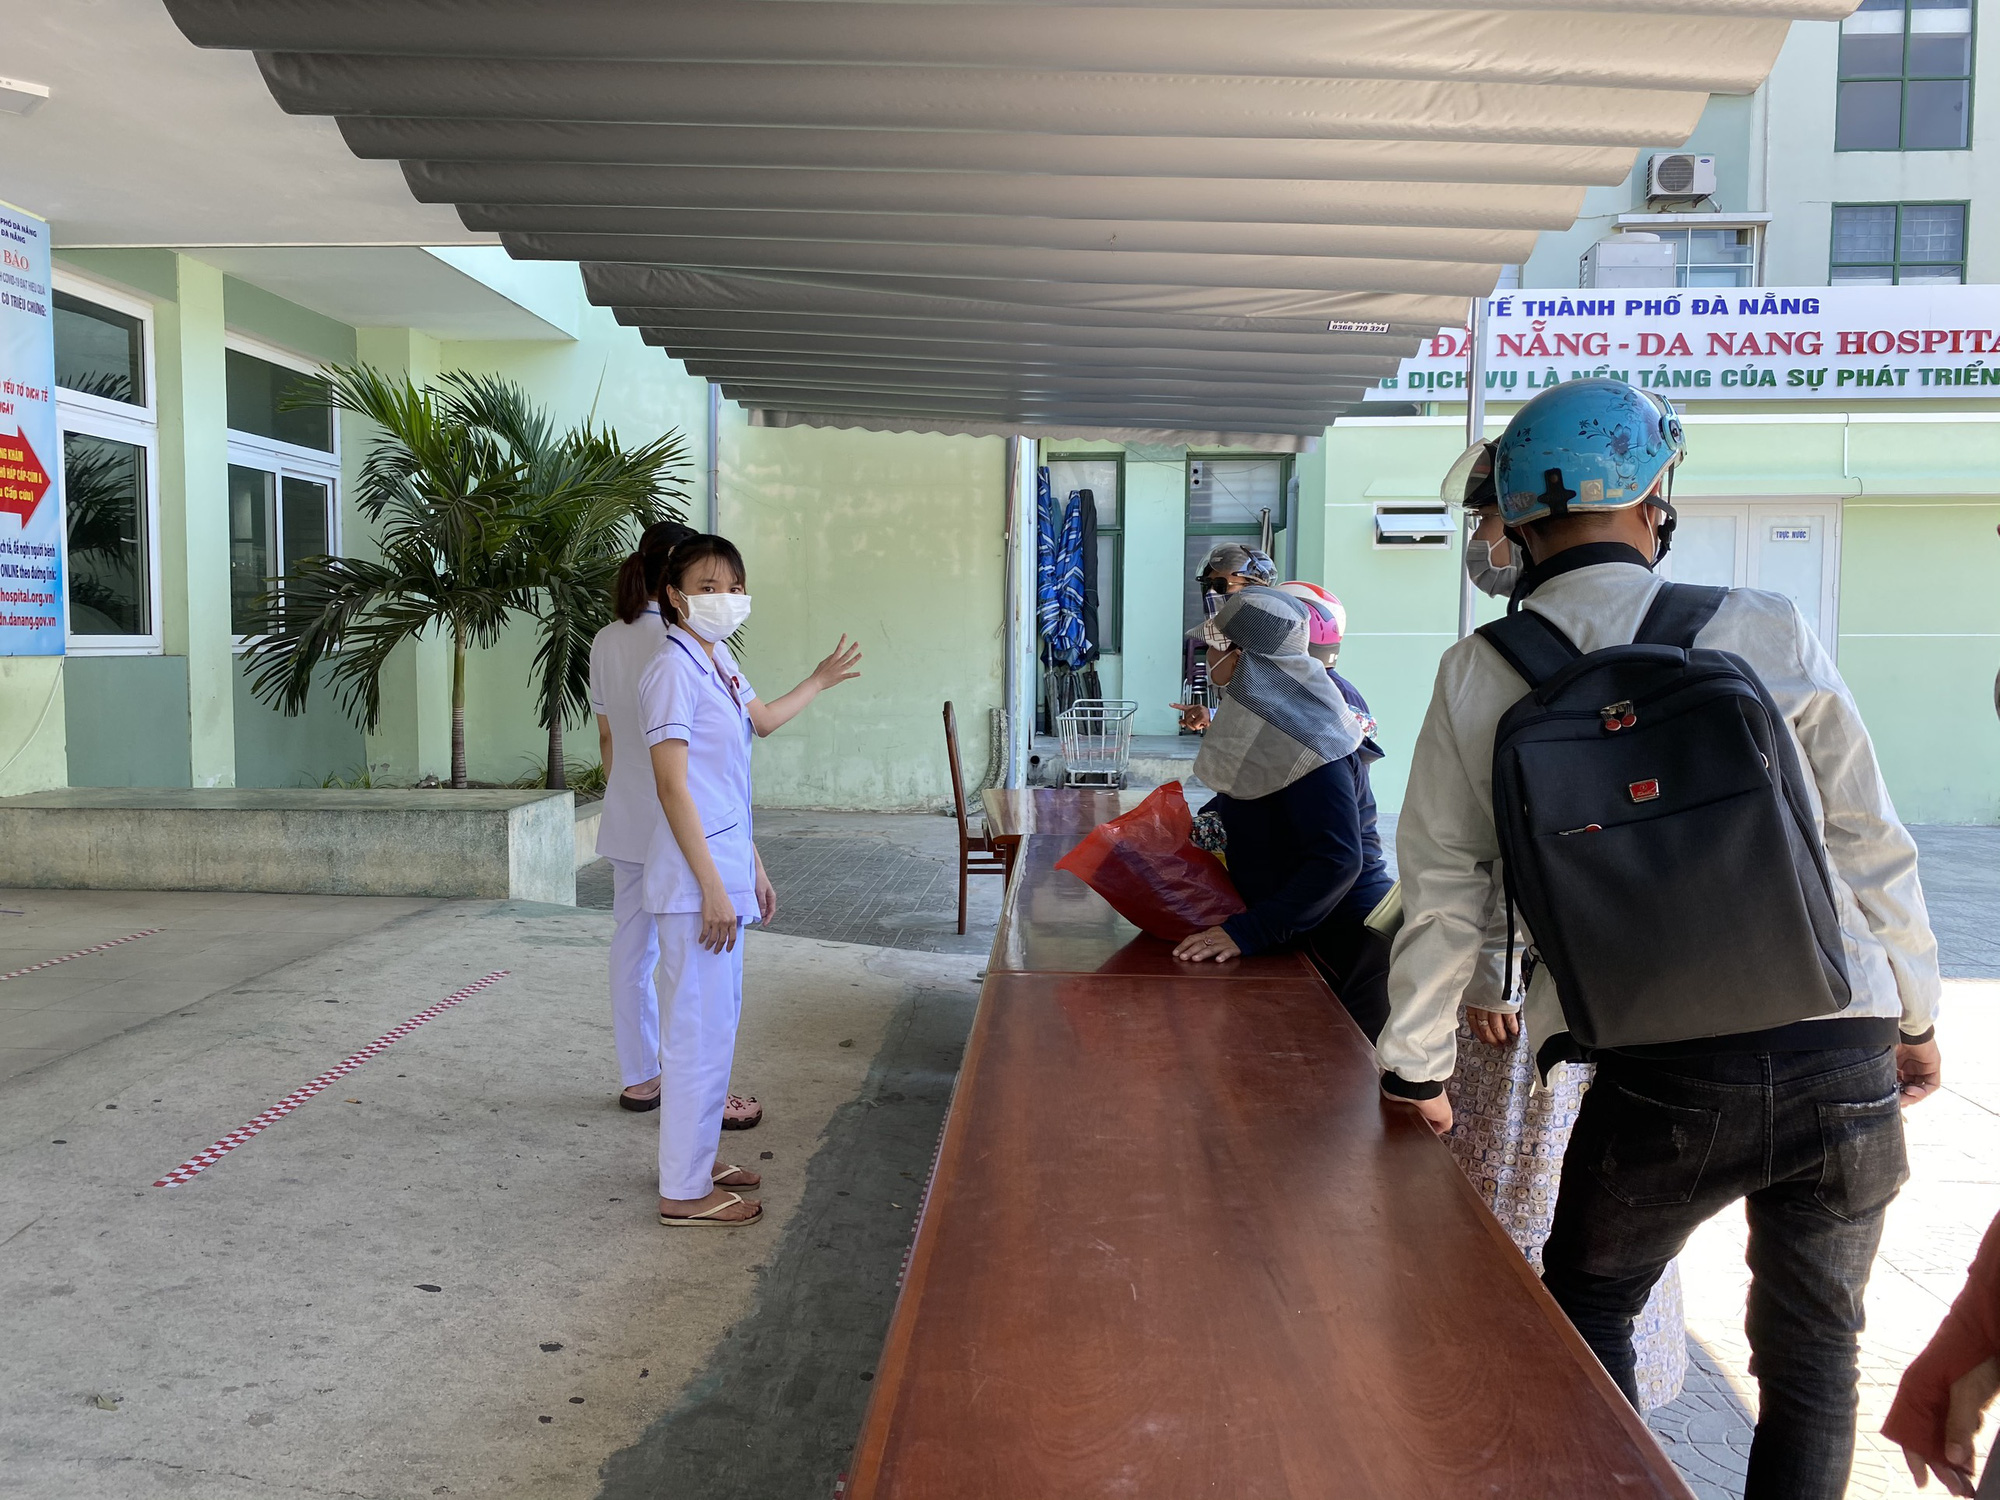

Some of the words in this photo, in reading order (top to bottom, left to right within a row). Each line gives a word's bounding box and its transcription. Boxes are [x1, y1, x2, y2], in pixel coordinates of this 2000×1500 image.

[1522, 296, 1615, 316] THÀNH
[1625, 294, 1682, 316] PHỐ
[1691, 294, 1729, 315] ĐÀ
[1739, 292, 1820, 315] NẴNG
[1496, 320, 1610, 357] NẴNG
[1637, 332, 1693, 356] DA
[1707, 331, 1824, 356] NANG
[1408, 371, 1470, 392] DỊCH
[1485, 371, 1517, 392] VỤ
[1527, 366, 1560, 388] LÀ
[1638, 364, 1711, 388] TẢNG
[1721, 364, 1777, 387] CỦA
[1787, 367, 1828, 391] SỰ
[1837, 364, 1909, 387] PHÁT
[1918, 360, 2000, 386] TRIỂN
[1, 564, 19, 578] ONLINE
[20, 565, 30, 578] theo
